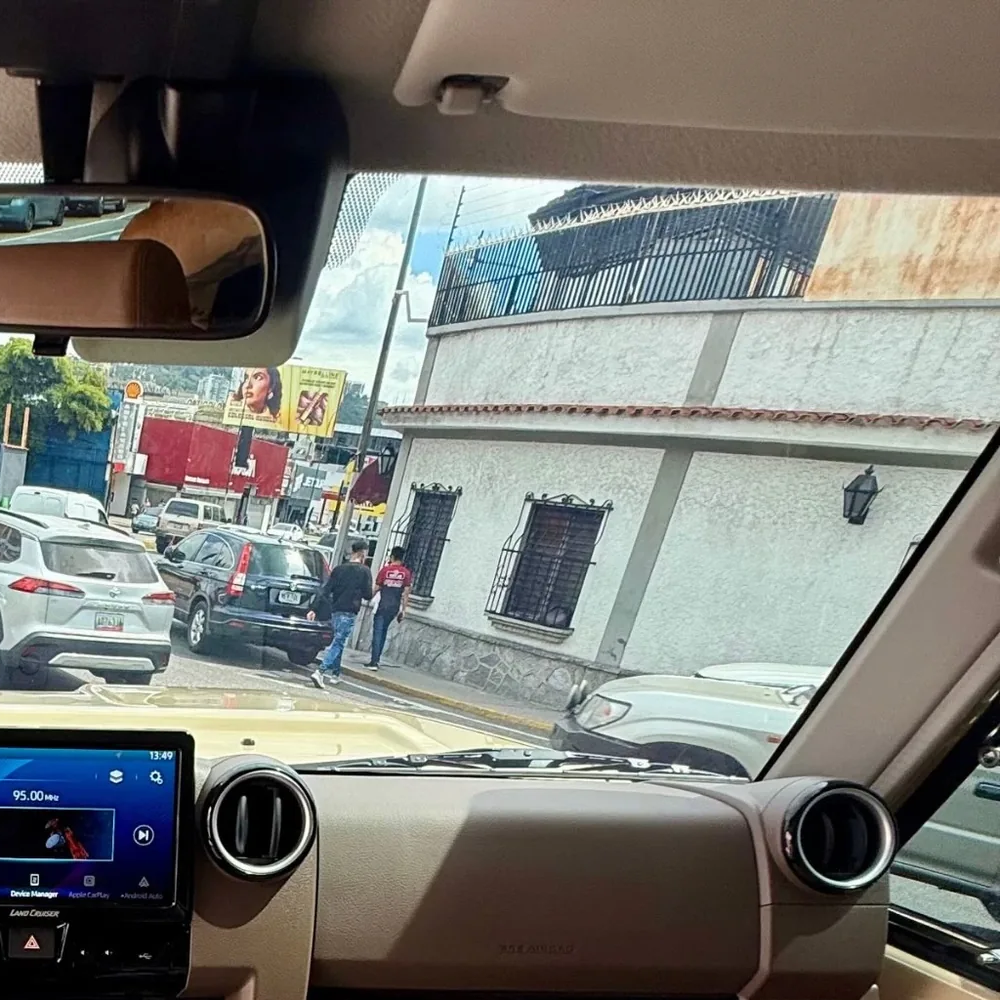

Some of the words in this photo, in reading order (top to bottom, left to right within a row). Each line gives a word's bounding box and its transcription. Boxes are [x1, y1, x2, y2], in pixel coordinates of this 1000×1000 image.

[150, 751, 173, 760] 13:49
[13, 790, 44, 801] 95.00
[10, 890, 30, 898] Device
[31, 891, 58, 899] Manager
[68, 891, 86, 899] Apple
[87, 891, 110, 900] CarPlay
[9, 909, 29, 917] LAND
[30, 909, 60, 918] CRUISER
